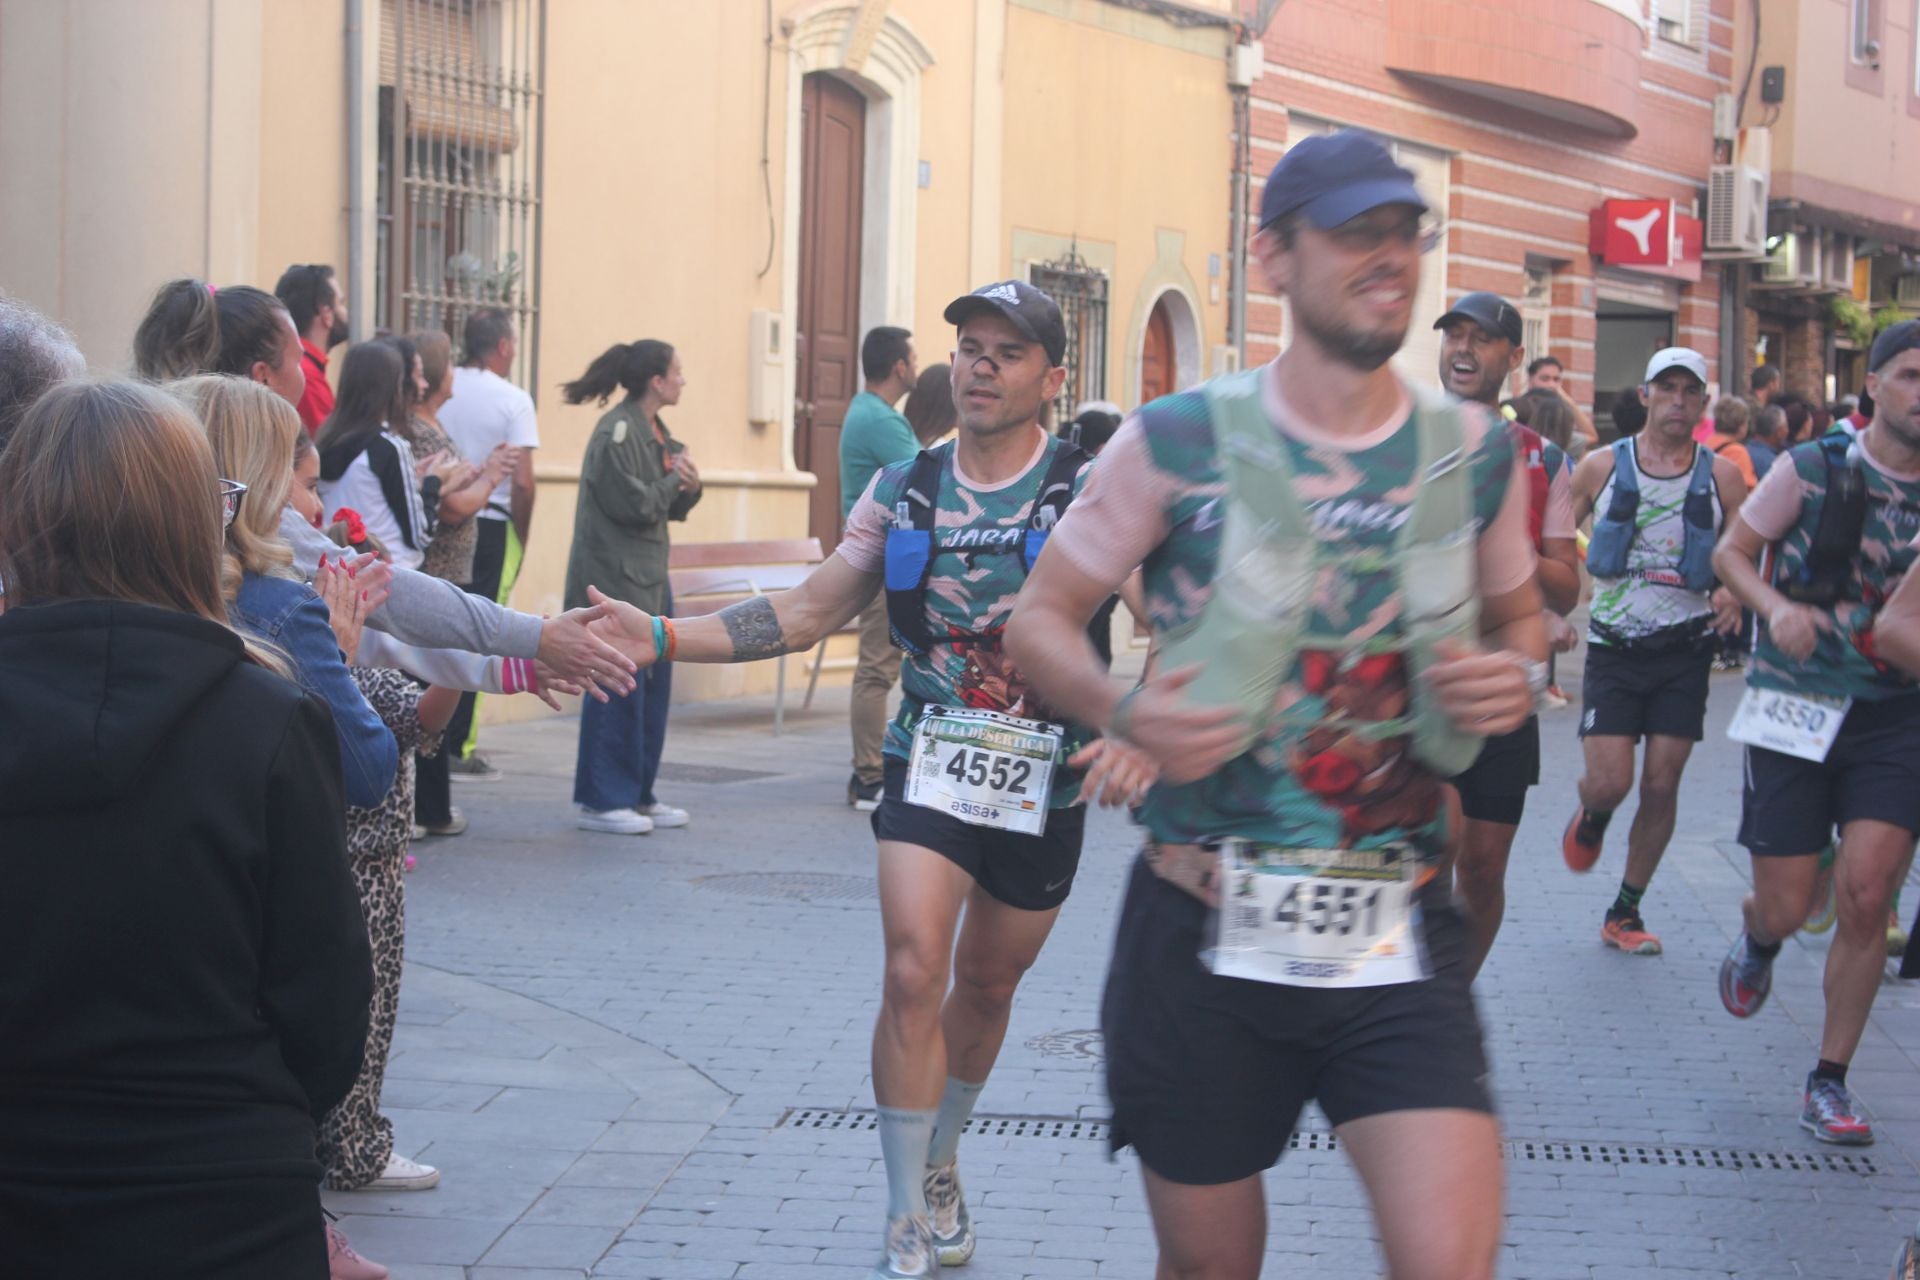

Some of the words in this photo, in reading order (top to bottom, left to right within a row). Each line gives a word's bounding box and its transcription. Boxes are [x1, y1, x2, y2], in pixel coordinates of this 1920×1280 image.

[1764, 698, 1826, 732] 4550
[946, 748, 1031, 795] 4552
[1274, 882, 1382, 938] 4551
